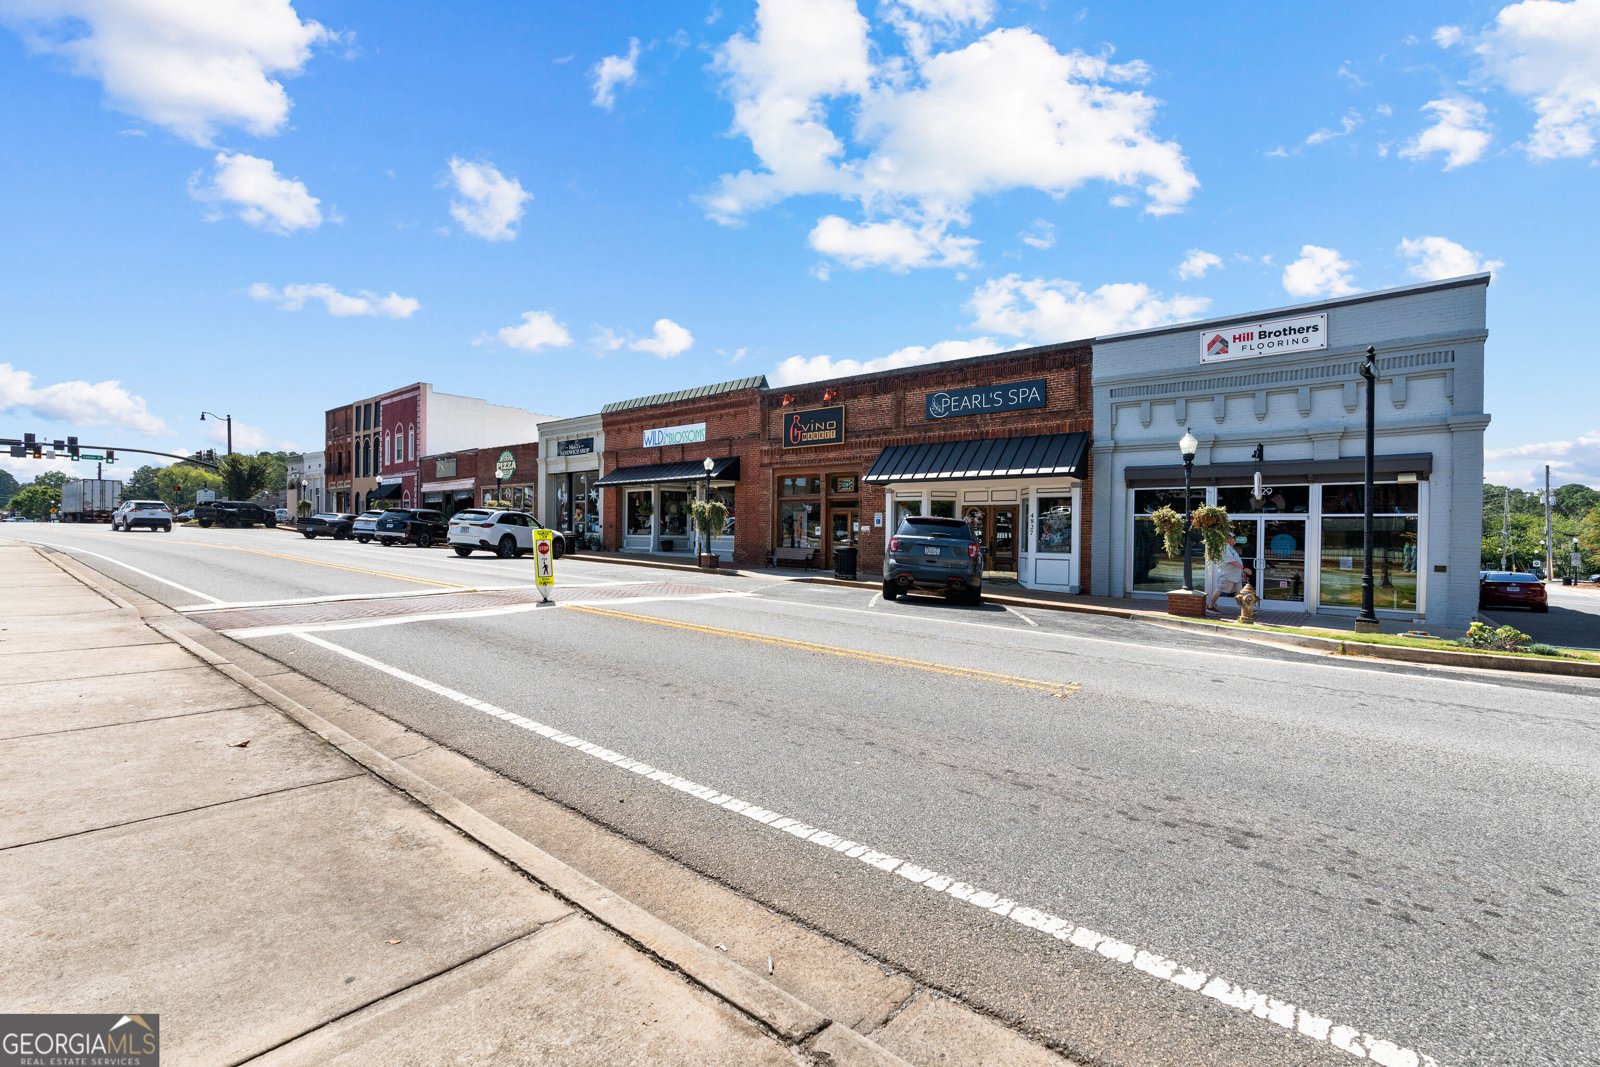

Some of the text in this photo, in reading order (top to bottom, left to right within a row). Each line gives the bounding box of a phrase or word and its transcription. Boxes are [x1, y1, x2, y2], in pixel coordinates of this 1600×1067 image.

[1232, 324, 1319, 343] Hill Brothers
[1241, 336, 1310, 352] FLOORING
[941, 386, 1041, 413] PEARL'S SPA
[644, 428, 705, 446] WILD BLOSSOMS
[802, 429, 836, 442] MARKET
[496, 460, 516, 470] PIZZA
